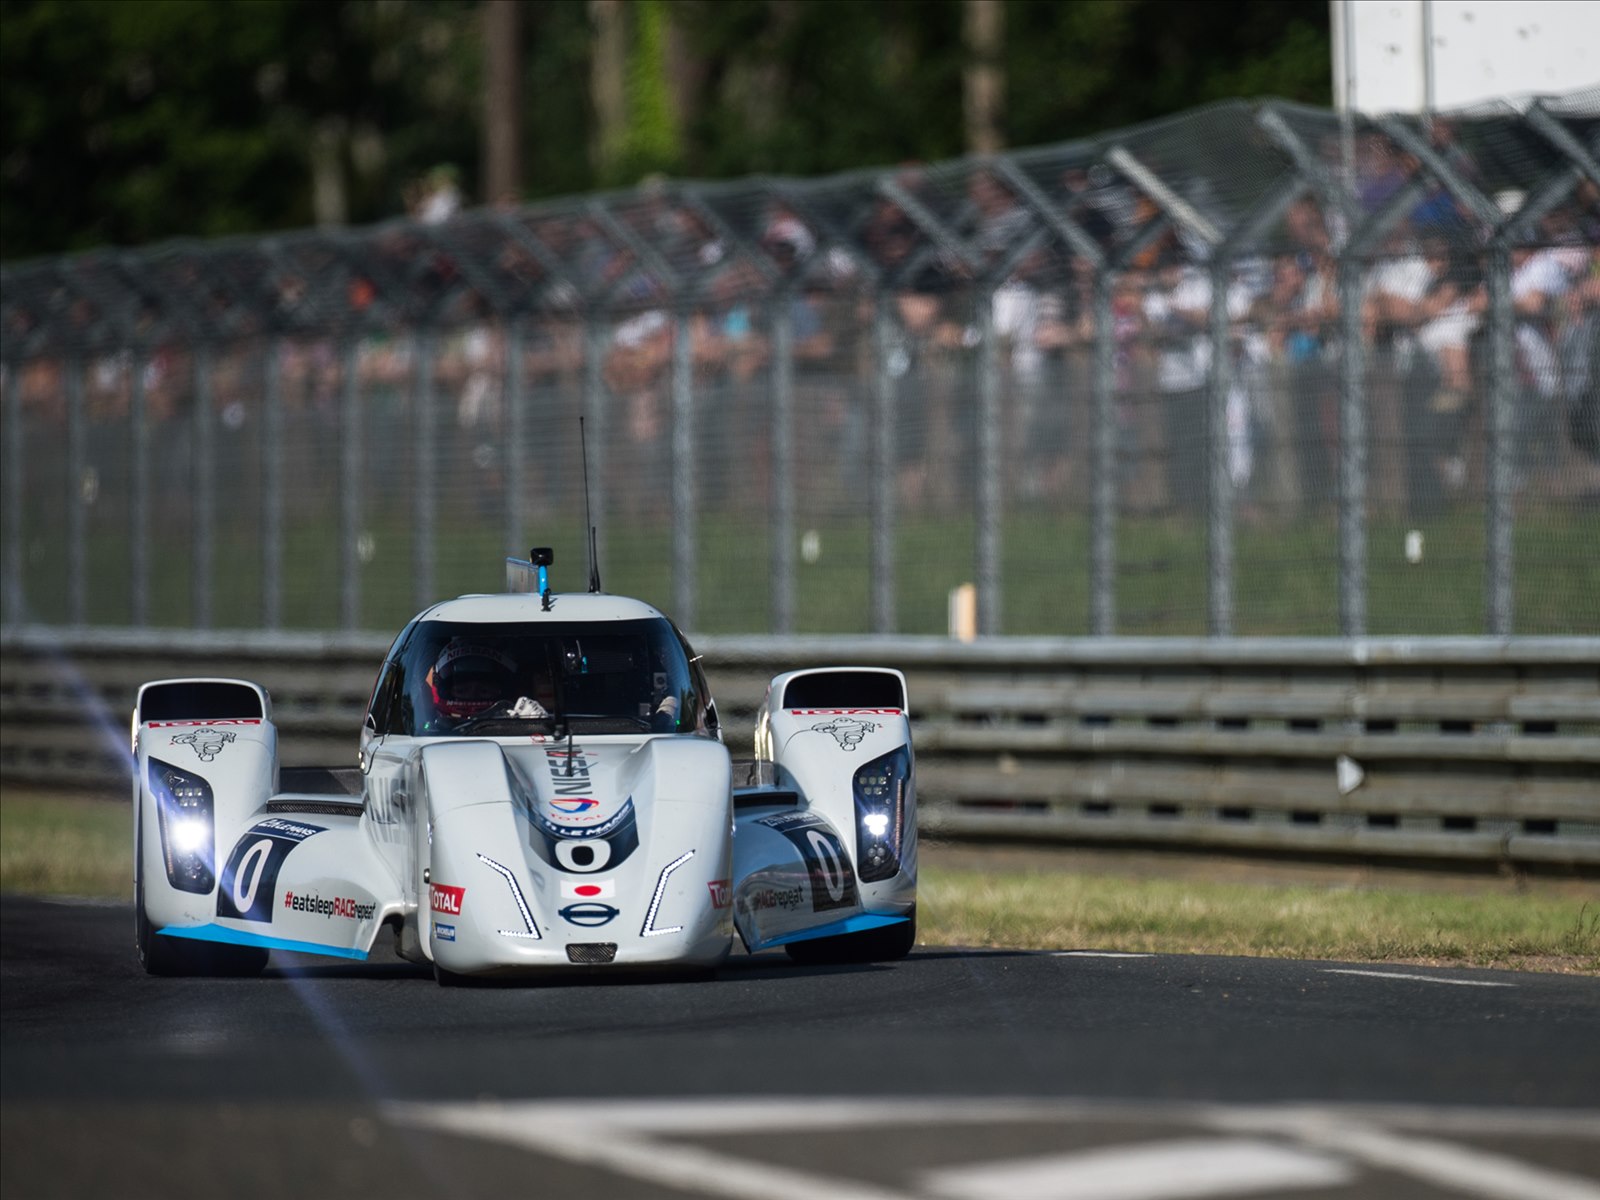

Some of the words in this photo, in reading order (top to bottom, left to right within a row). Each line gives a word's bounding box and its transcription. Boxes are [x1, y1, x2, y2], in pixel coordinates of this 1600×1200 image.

[542, 741, 593, 795] NISSAN
[548, 812, 604, 821] TOTAL
[586, 804, 631, 836] MANS
[555, 839, 611, 872] 0
[806, 830, 844, 902] 0
[233, 838, 274, 914] 0
[284, 891, 377, 922] #eatsleepRACErepeat
[430, 886, 460, 912] TOTAL
